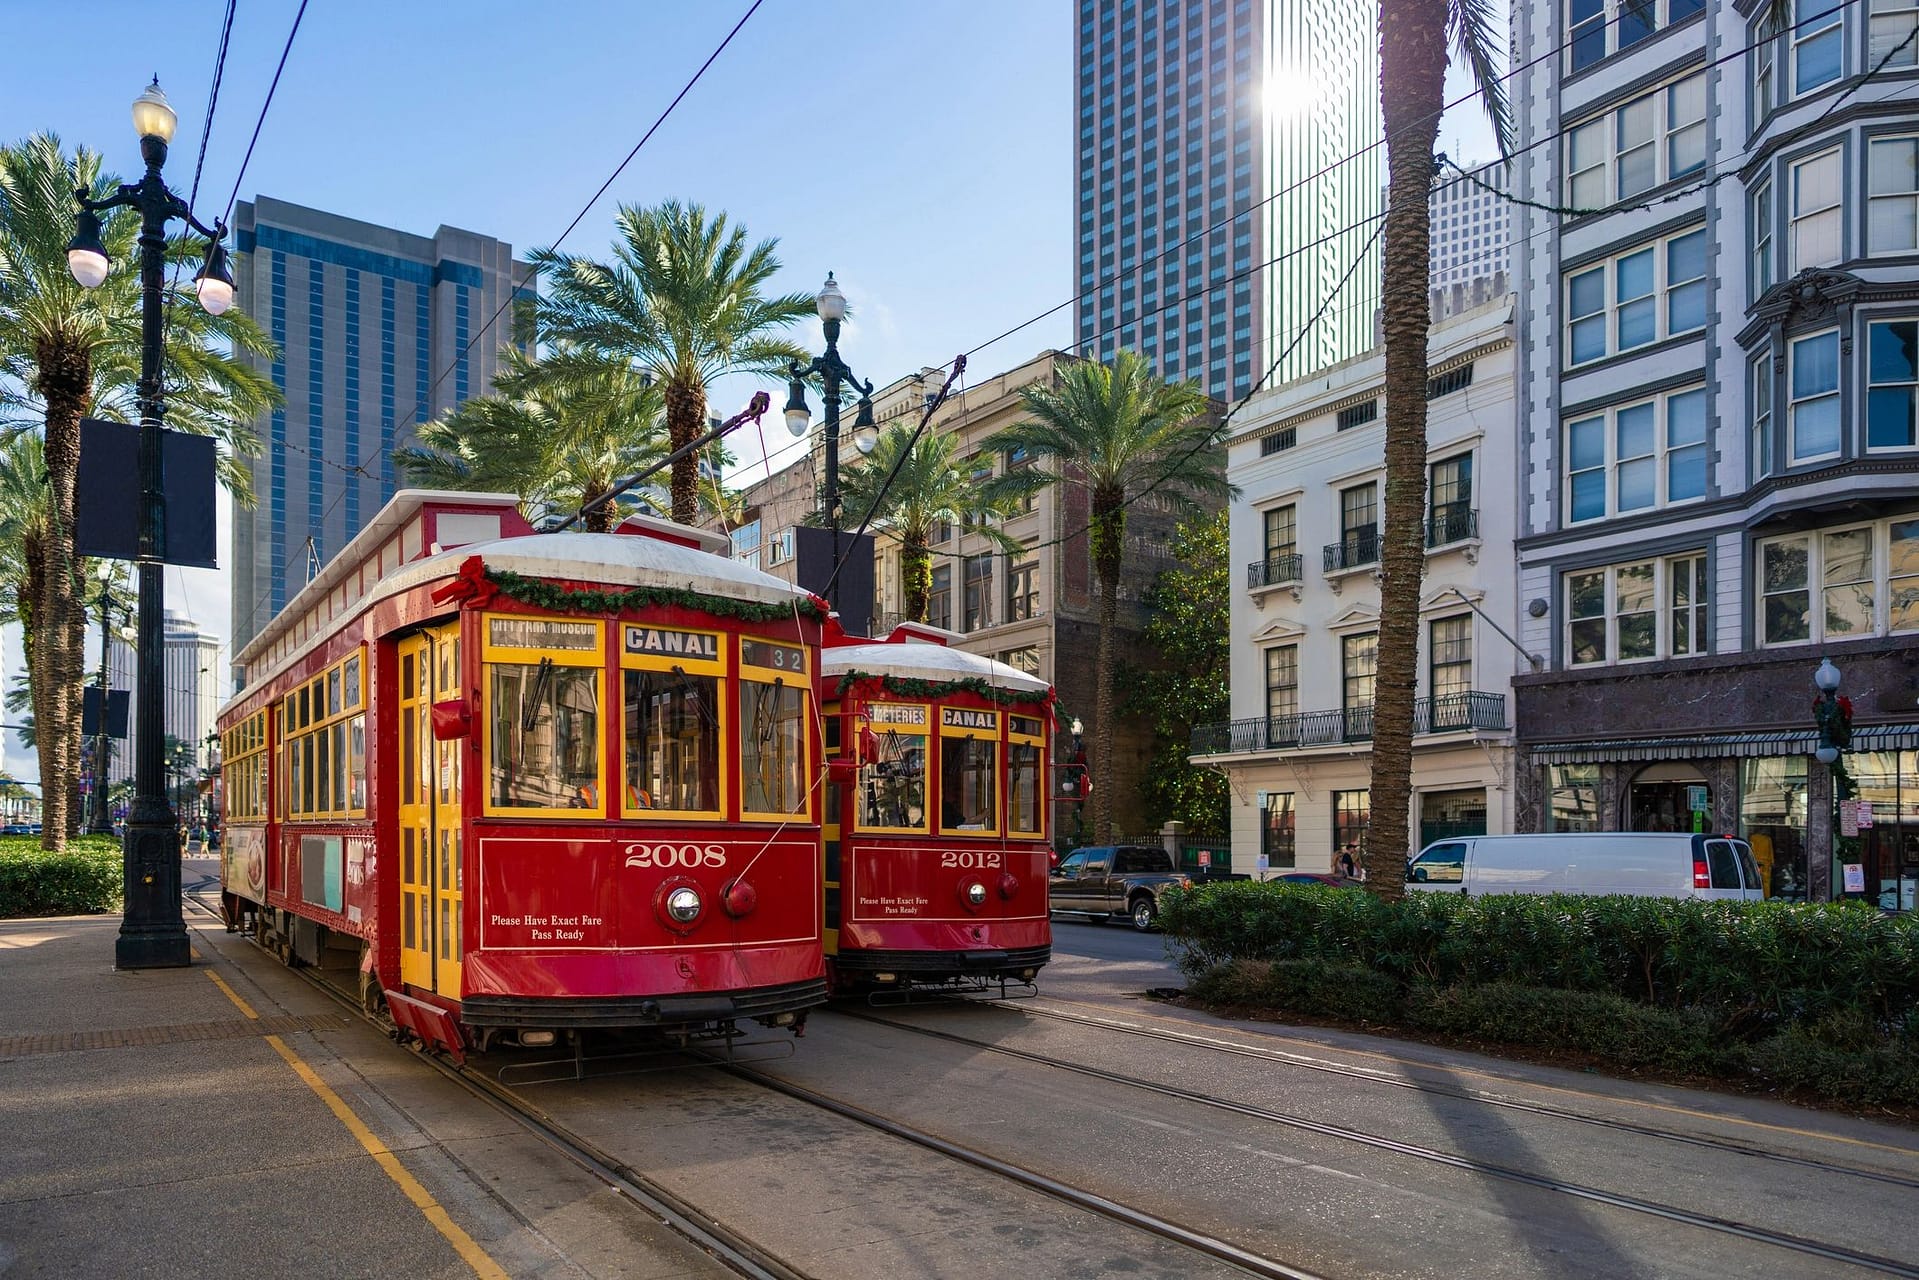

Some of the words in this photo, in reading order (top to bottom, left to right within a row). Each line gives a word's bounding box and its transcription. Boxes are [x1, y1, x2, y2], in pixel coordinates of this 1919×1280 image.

[626, 627, 717, 656] CANAL
[943, 708, 995, 728] CANAL
[625, 844, 727, 868] 2008
[941, 852, 1000, 869] 2012
[859, 897, 878, 905] Please
[880, 897, 895, 905] Have
[897, 897, 914, 905] Exact
[916, 897, 928, 905] Fare
[885, 906, 898, 914] Pass
[900, 906, 918, 915] Ready
[491, 914, 520, 926] Please
[524, 914, 547, 926] Have
[551, 914, 578, 926] Exact
[582, 914, 602, 926] Fare
[531, 929, 552, 940] Pass
[556, 929, 584, 941] Ready
